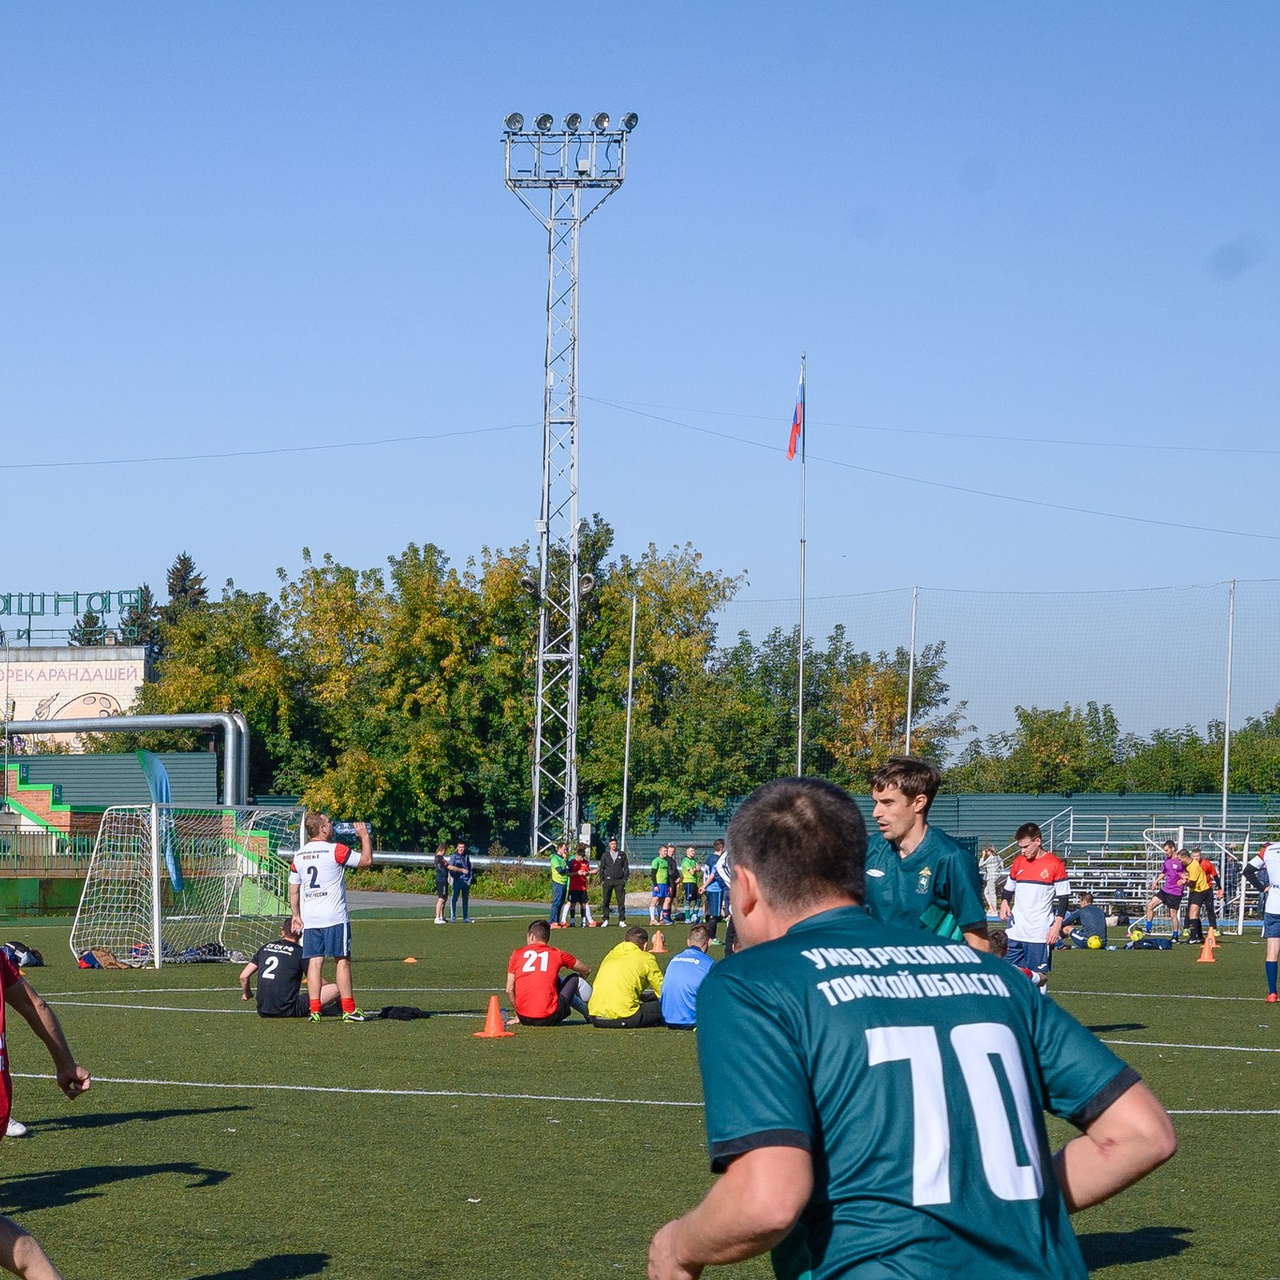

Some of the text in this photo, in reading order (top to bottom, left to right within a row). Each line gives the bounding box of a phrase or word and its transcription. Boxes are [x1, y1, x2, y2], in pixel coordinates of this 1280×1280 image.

[306, 865, 321, 889] 2
[262, 955, 279, 980] 2
[522, 949, 549, 972] 21
[801, 944, 982, 970] УМВД РОССИИ ПО
[816, 970, 1011, 1006] ТОМСКОЙ ОБЛАСТИ
[864, 1022, 1045, 1207] 70
